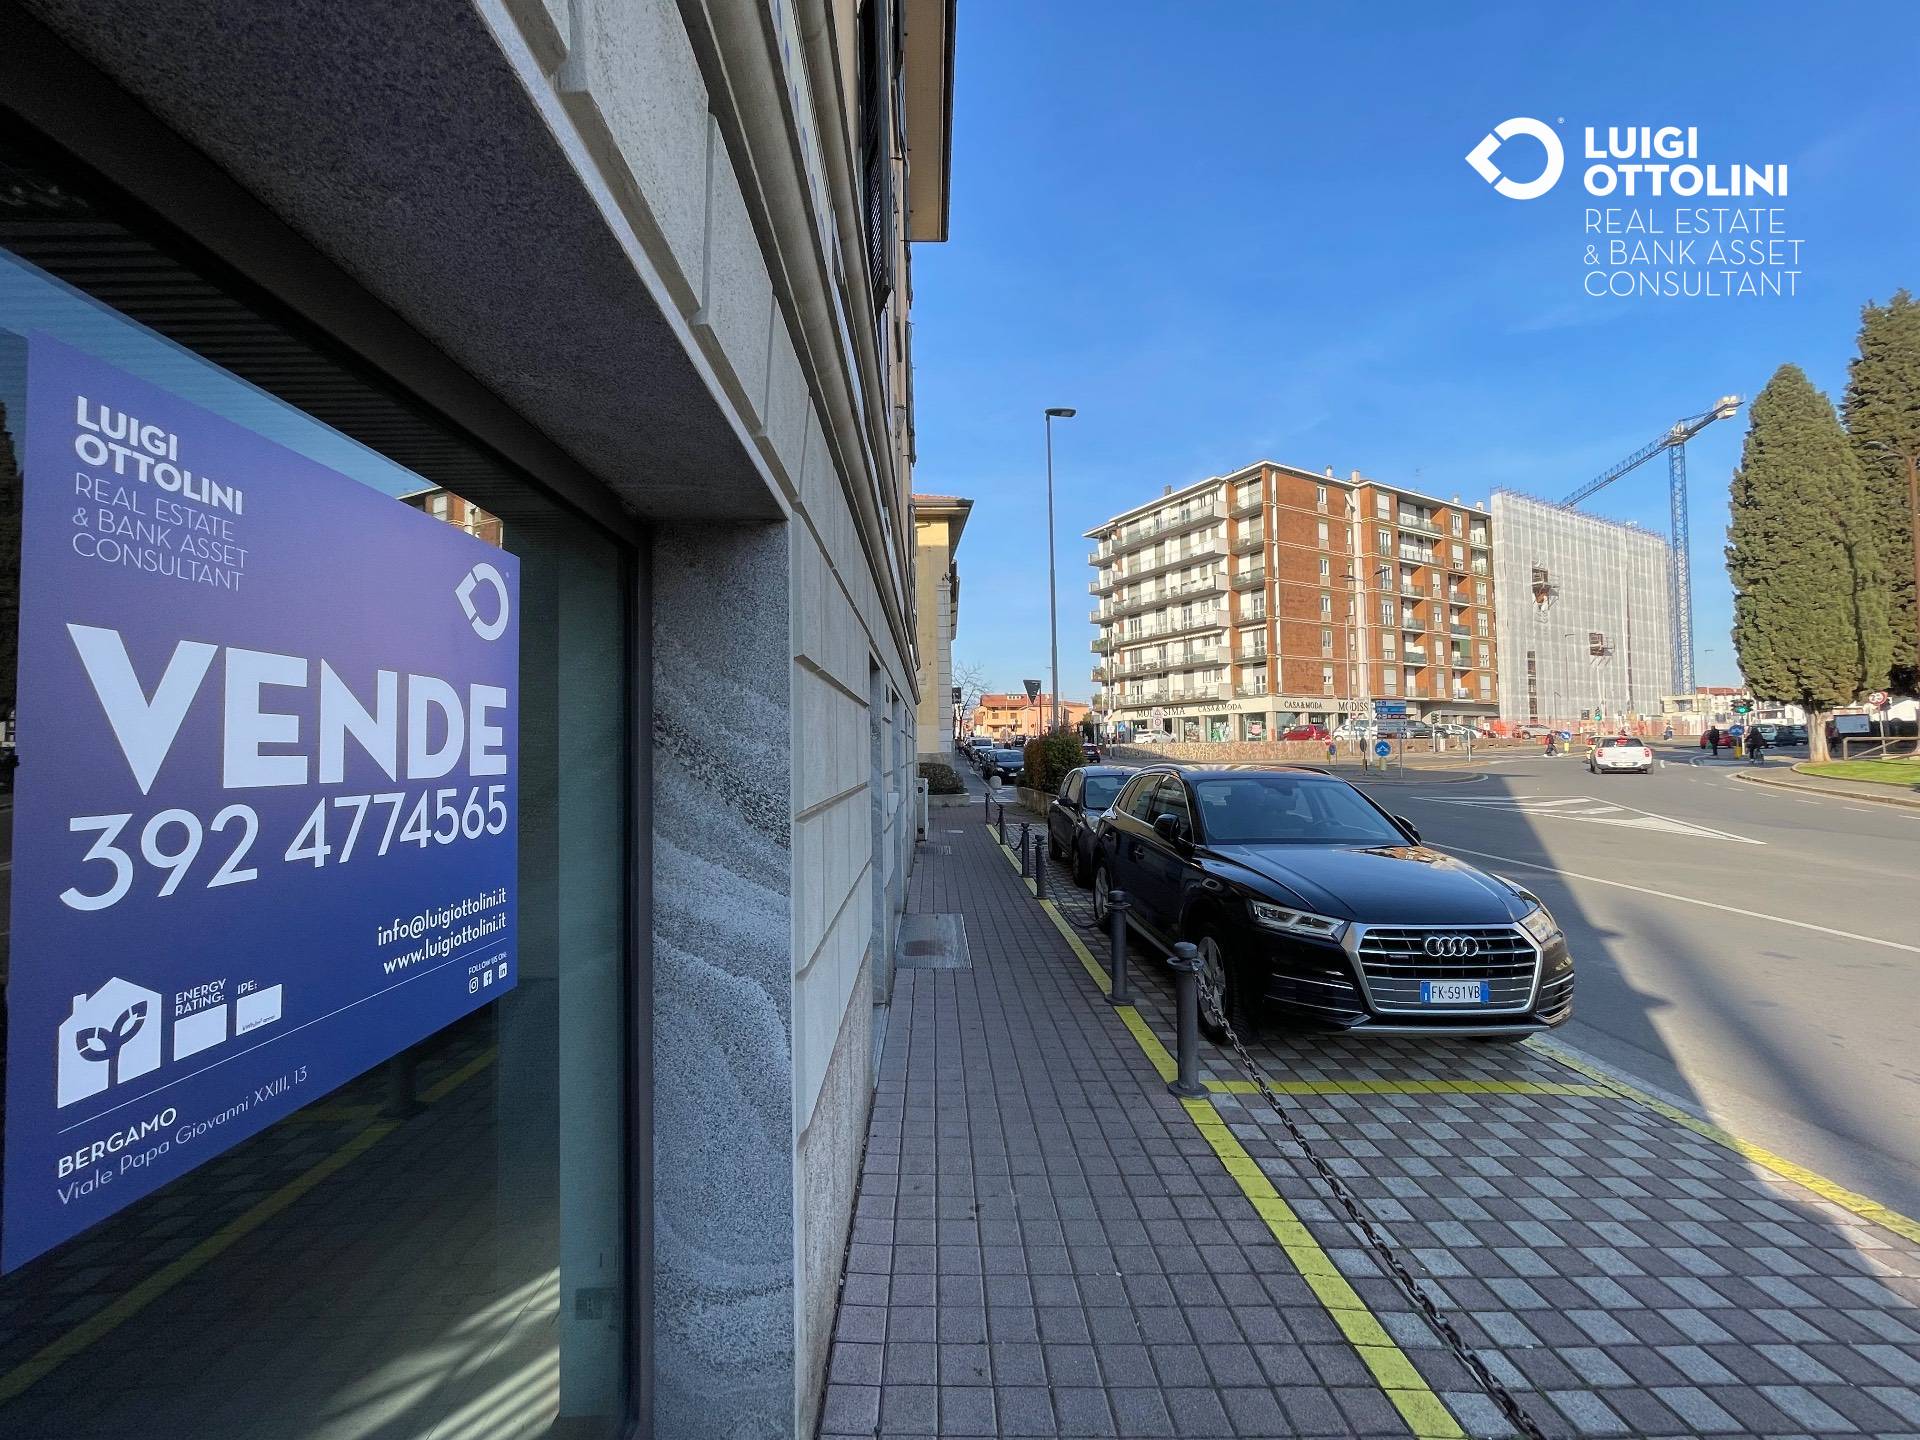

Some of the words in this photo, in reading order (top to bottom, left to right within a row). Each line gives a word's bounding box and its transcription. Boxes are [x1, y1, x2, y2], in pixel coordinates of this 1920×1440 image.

[76, 395, 178, 462] LUIGI
[75, 433, 243, 515] OTTOLINI
[72, 507, 89, 527] &
[98, 508, 172, 550] BANK
[180, 534, 248, 568] ASSET
[75, 472, 146, 515] REAL
[155, 498, 235, 542] ESTATE
[72, 532, 245, 591] CONSULTANT
[66, 622, 508, 795] VENDE
[59, 803, 259, 911] 392
[284, 784, 508, 868] 4774565
[378, 887, 506, 946] info@luigiottolini.it
[383, 912, 506, 975] www.luigiottolini.it
[175, 978, 227, 1005] ENERGY
[237, 980, 258, 995] IPE:
[468, 959, 491, 975] FOLLOW
[175, 992, 225, 1017] RATING:
[57, 1169, 113, 1206] Viale
[119, 1141, 170, 1175] Papa
[175, 1095, 249, 1144] Giovanni
[252, 1075, 291, 1107] XXIII,
[294, 1065, 308, 1086] 13
[57, 1107, 177, 1179] BERGAMO
